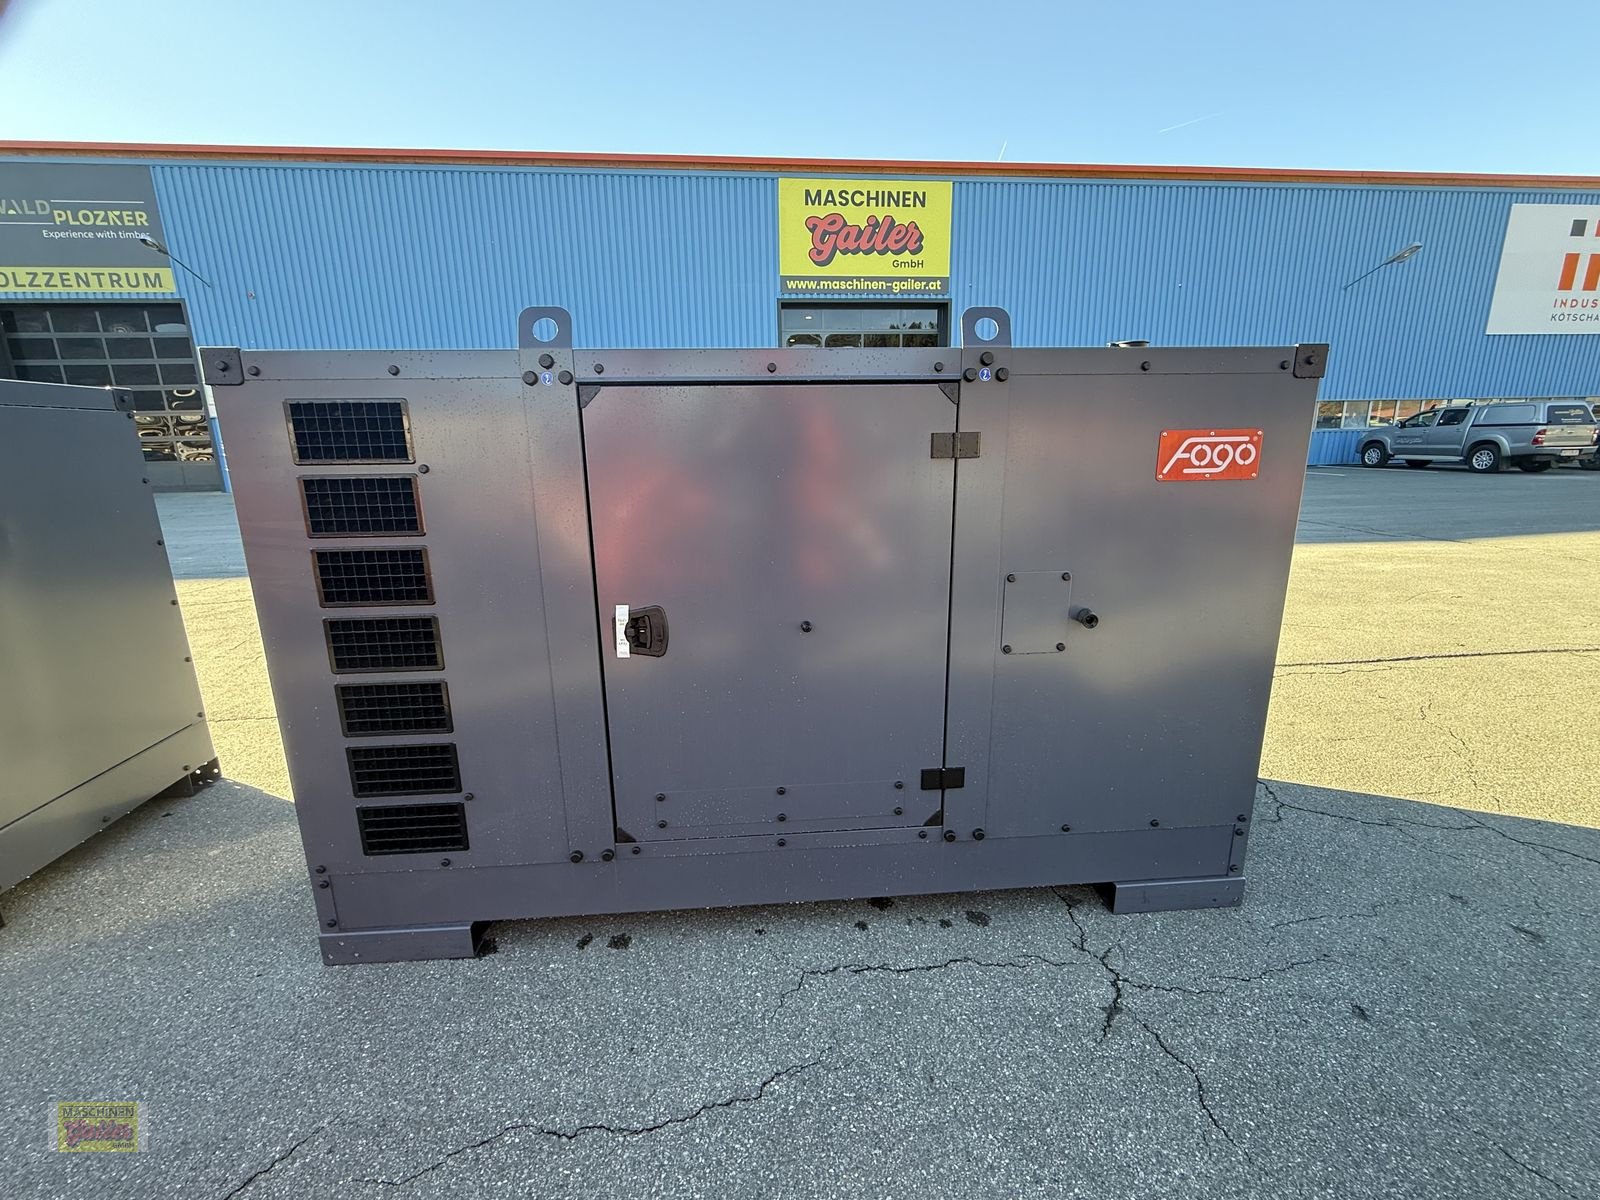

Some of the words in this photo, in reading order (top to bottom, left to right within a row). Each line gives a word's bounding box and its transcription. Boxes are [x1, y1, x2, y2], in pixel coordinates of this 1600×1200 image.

[804, 189, 927, 208] MASCHINEN
[42, 229, 94, 240] Experience
[95, 230, 117, 239] with
[805, 212, 924, 267] Gailer
[892, 259, 924, 269] GmbH
[786, 278, 942, 293] www.maschinen-gailer.at
